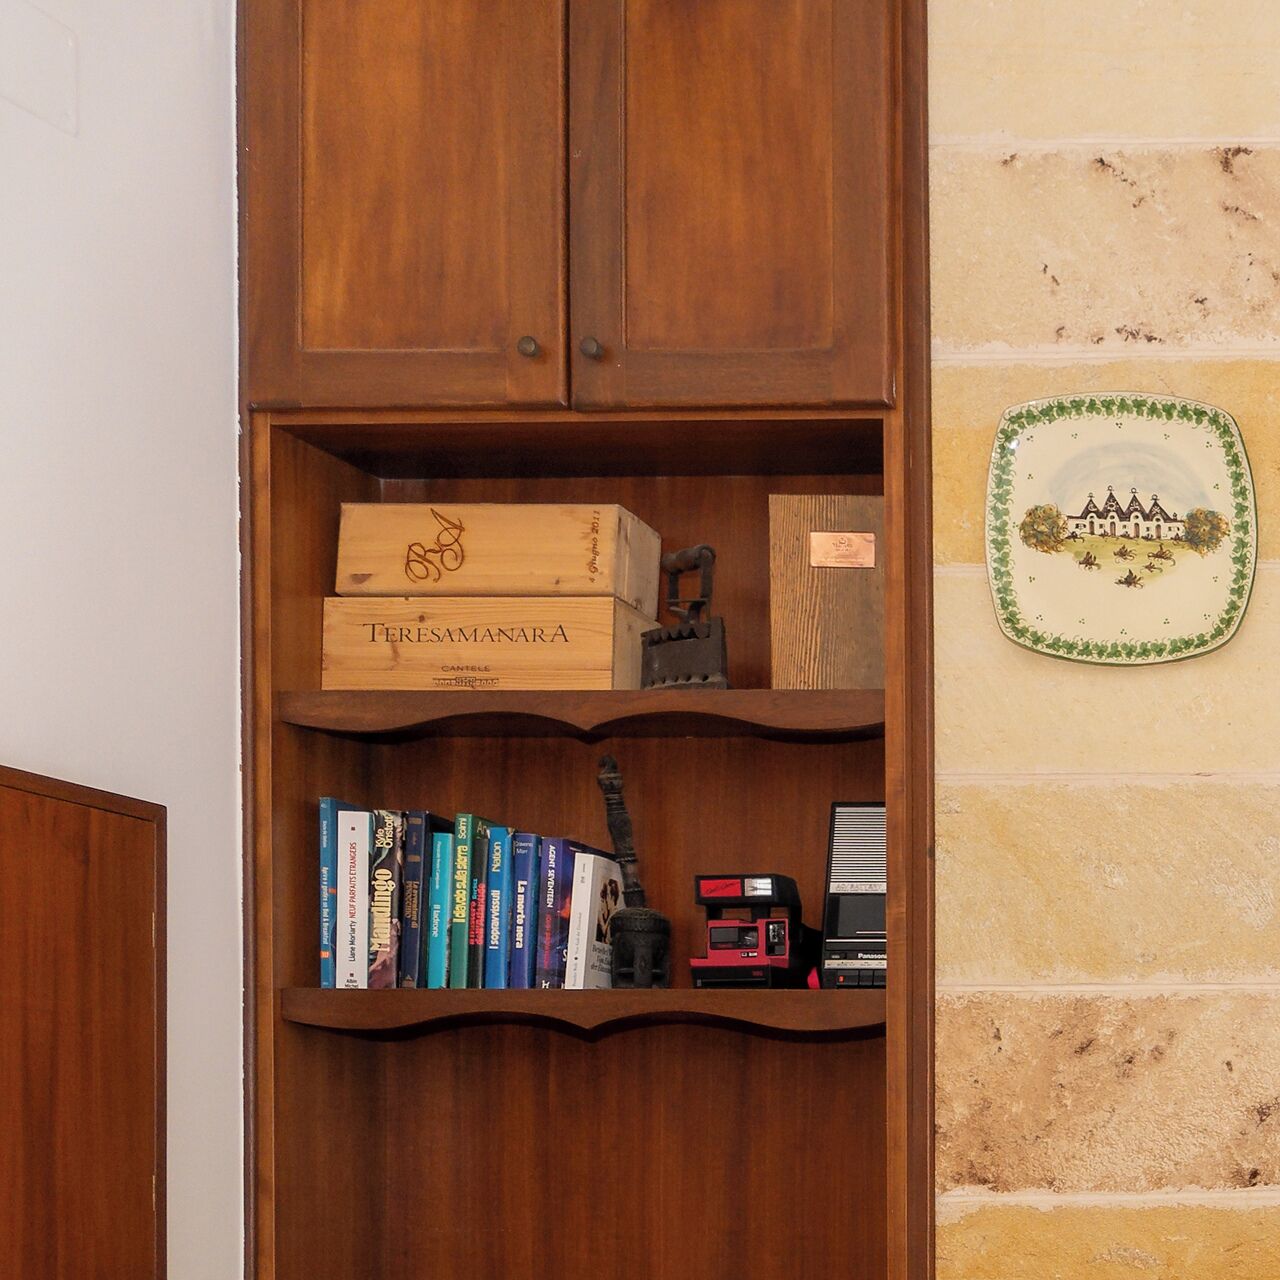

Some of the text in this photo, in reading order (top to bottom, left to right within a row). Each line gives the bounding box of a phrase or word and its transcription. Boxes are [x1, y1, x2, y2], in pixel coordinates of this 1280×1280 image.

[591, 510, 600, 535] 2011
[588, 537, 600, 574] Giugno
[362, 622, 570, 643] TERESAMANARA
[441, 665, 491, 673] CANTELE
[375, 828, 384, 848] Kyle
[458, 817, 467, 840] Solmi
[455, 845, 469, 870] sierra
[491, 841, 502, 872] Nation
[548, 844, 556, 868] AGENT
[348, 877, 356, 903] PARFAITS
[454, 870, 467, 889] sulla
[546, 869, 555, 908] SEVENTEEN
[348, 903, 356, 918] NEUF
[369, 868, 396, 952] Mandingo
[453, 889, 467, 918] diavolo
[515, 880, 527, 949] La morte nera
[431, 910, 440, 938] ladrone
[489, 889, 501, 945] sopravvissuti
[348, 920, 357, 961] Liane Moriarty
